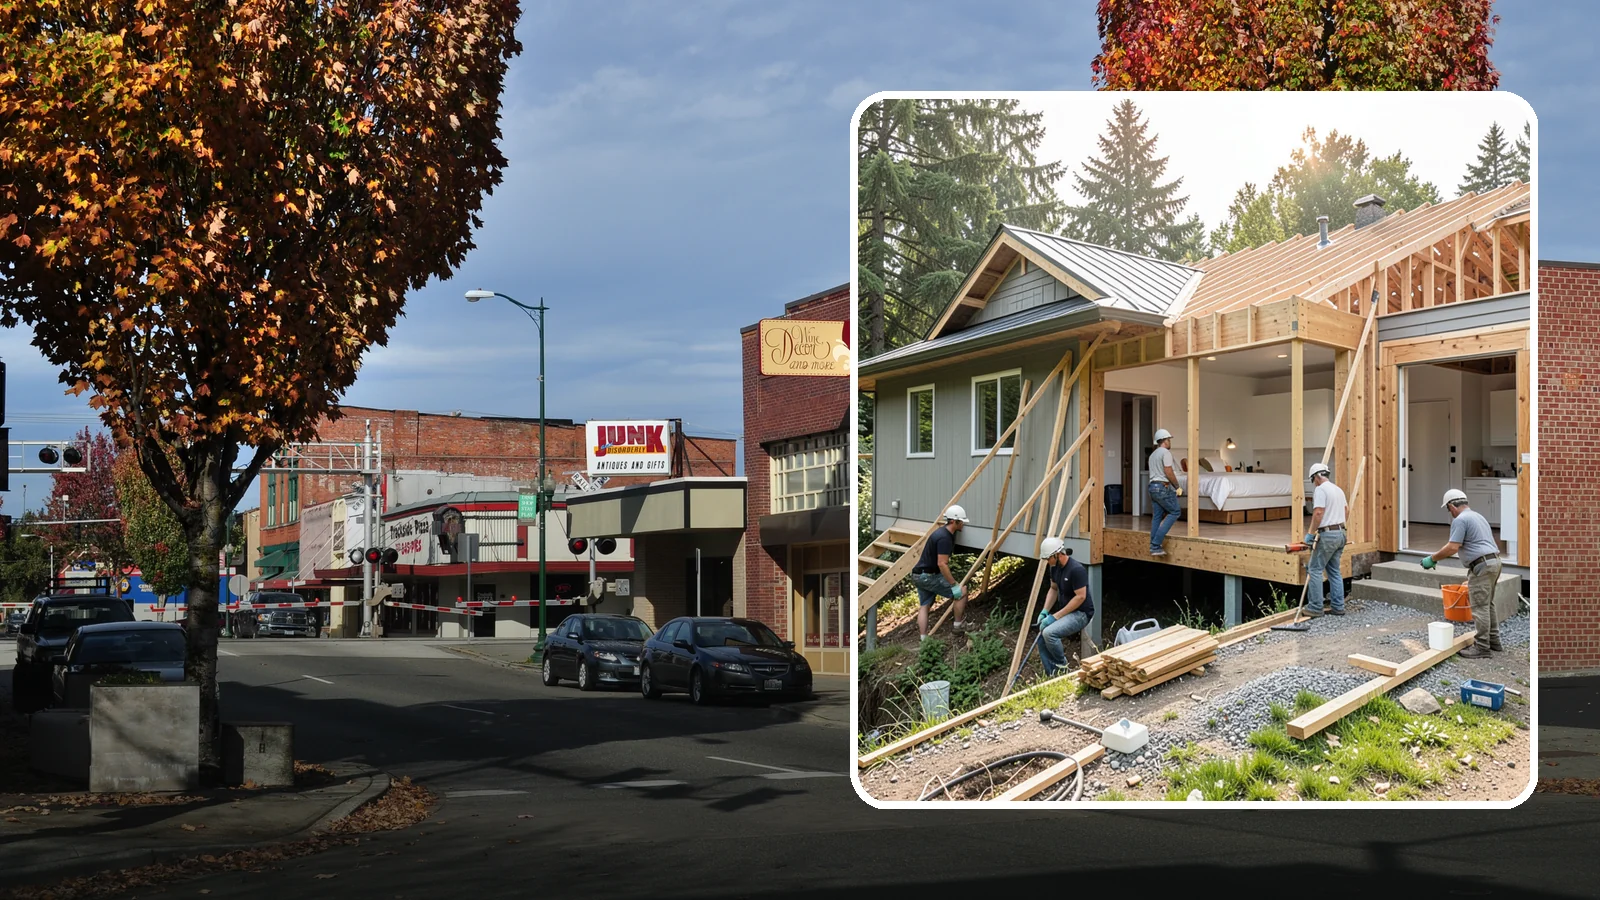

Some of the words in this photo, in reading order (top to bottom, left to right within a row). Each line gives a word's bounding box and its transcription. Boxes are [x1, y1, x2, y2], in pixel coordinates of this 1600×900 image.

[596, 425, 665, 457] JUNK
[607, 446, 646, 454] DISORDERLY
[597, 461, 628, 470] ANTIQUES
[631, 460, 644, 470] AND
[646, 460, 665, 470] GIFTS
[390, 521, 413, 540] Trackside
[414, 519, 429, 535] Pizza
